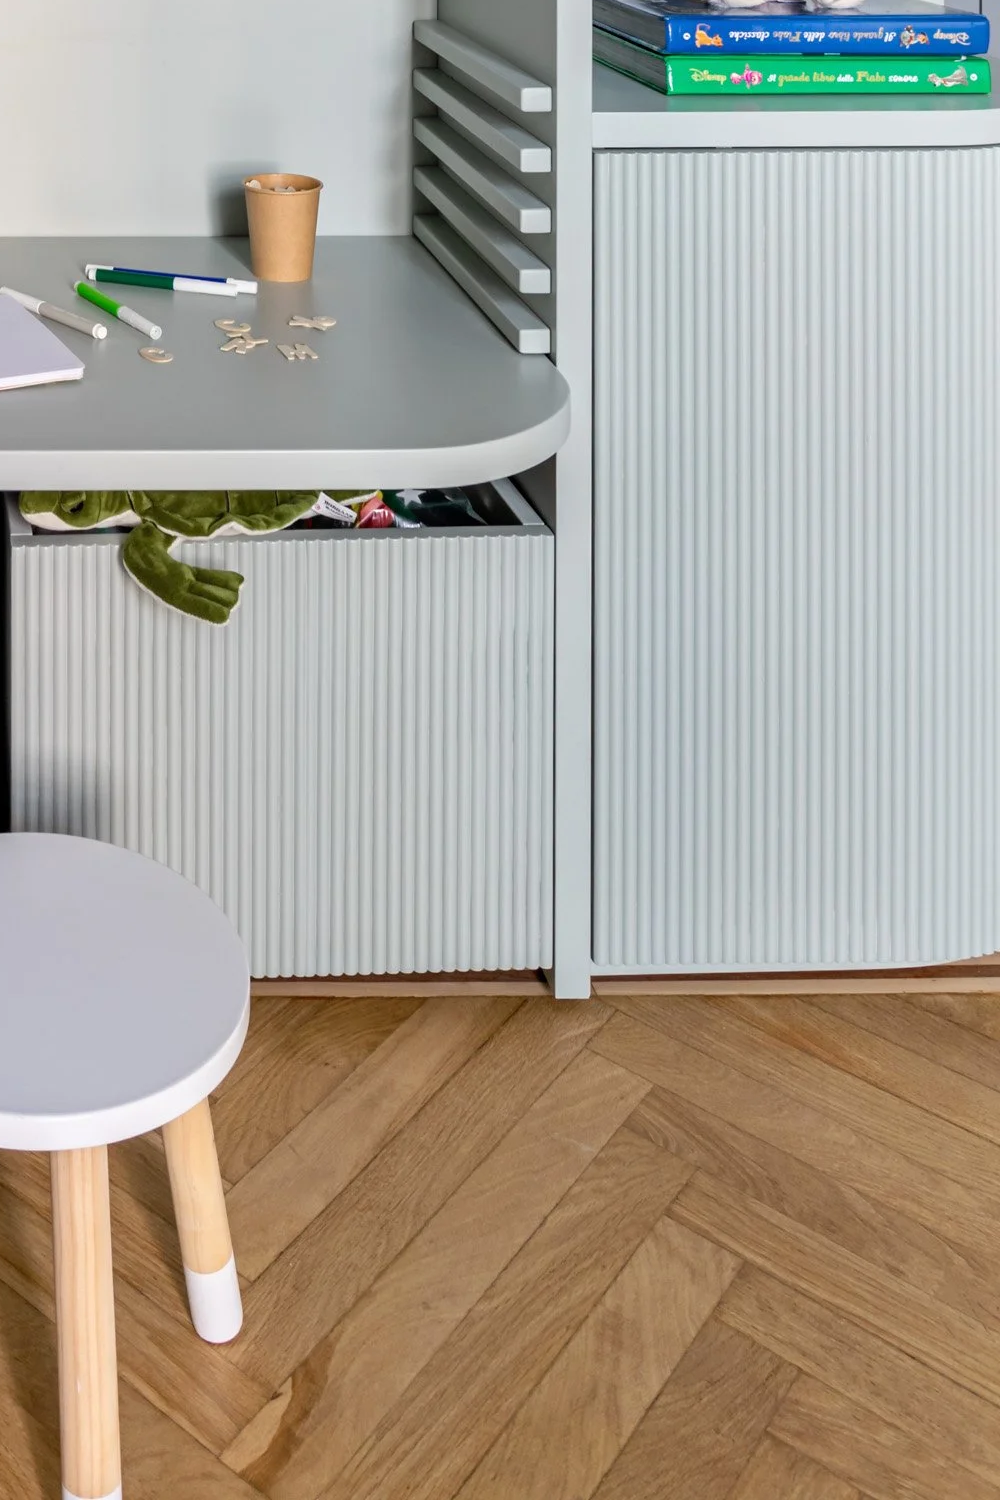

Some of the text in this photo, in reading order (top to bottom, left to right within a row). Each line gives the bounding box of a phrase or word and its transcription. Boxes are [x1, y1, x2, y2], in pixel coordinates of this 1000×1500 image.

[728, 30, 770, 42] classiche
[773, 31, 801, 42] Fiabe
[803, 31, 825, 42] delle
[828, 31, 850, 42] libro
[853, 26, 885, 42] grande
[932, 28, 972, 46] Disney
[689, 68, 727, 85] Disney
[778, 73, 810, 87] grande
[812, 71, 835, 82] libro
[837, 73, 855, 82] delle
[856, 71, 886, 82] Fiabe
[888, 75, 919, 83] sonore
